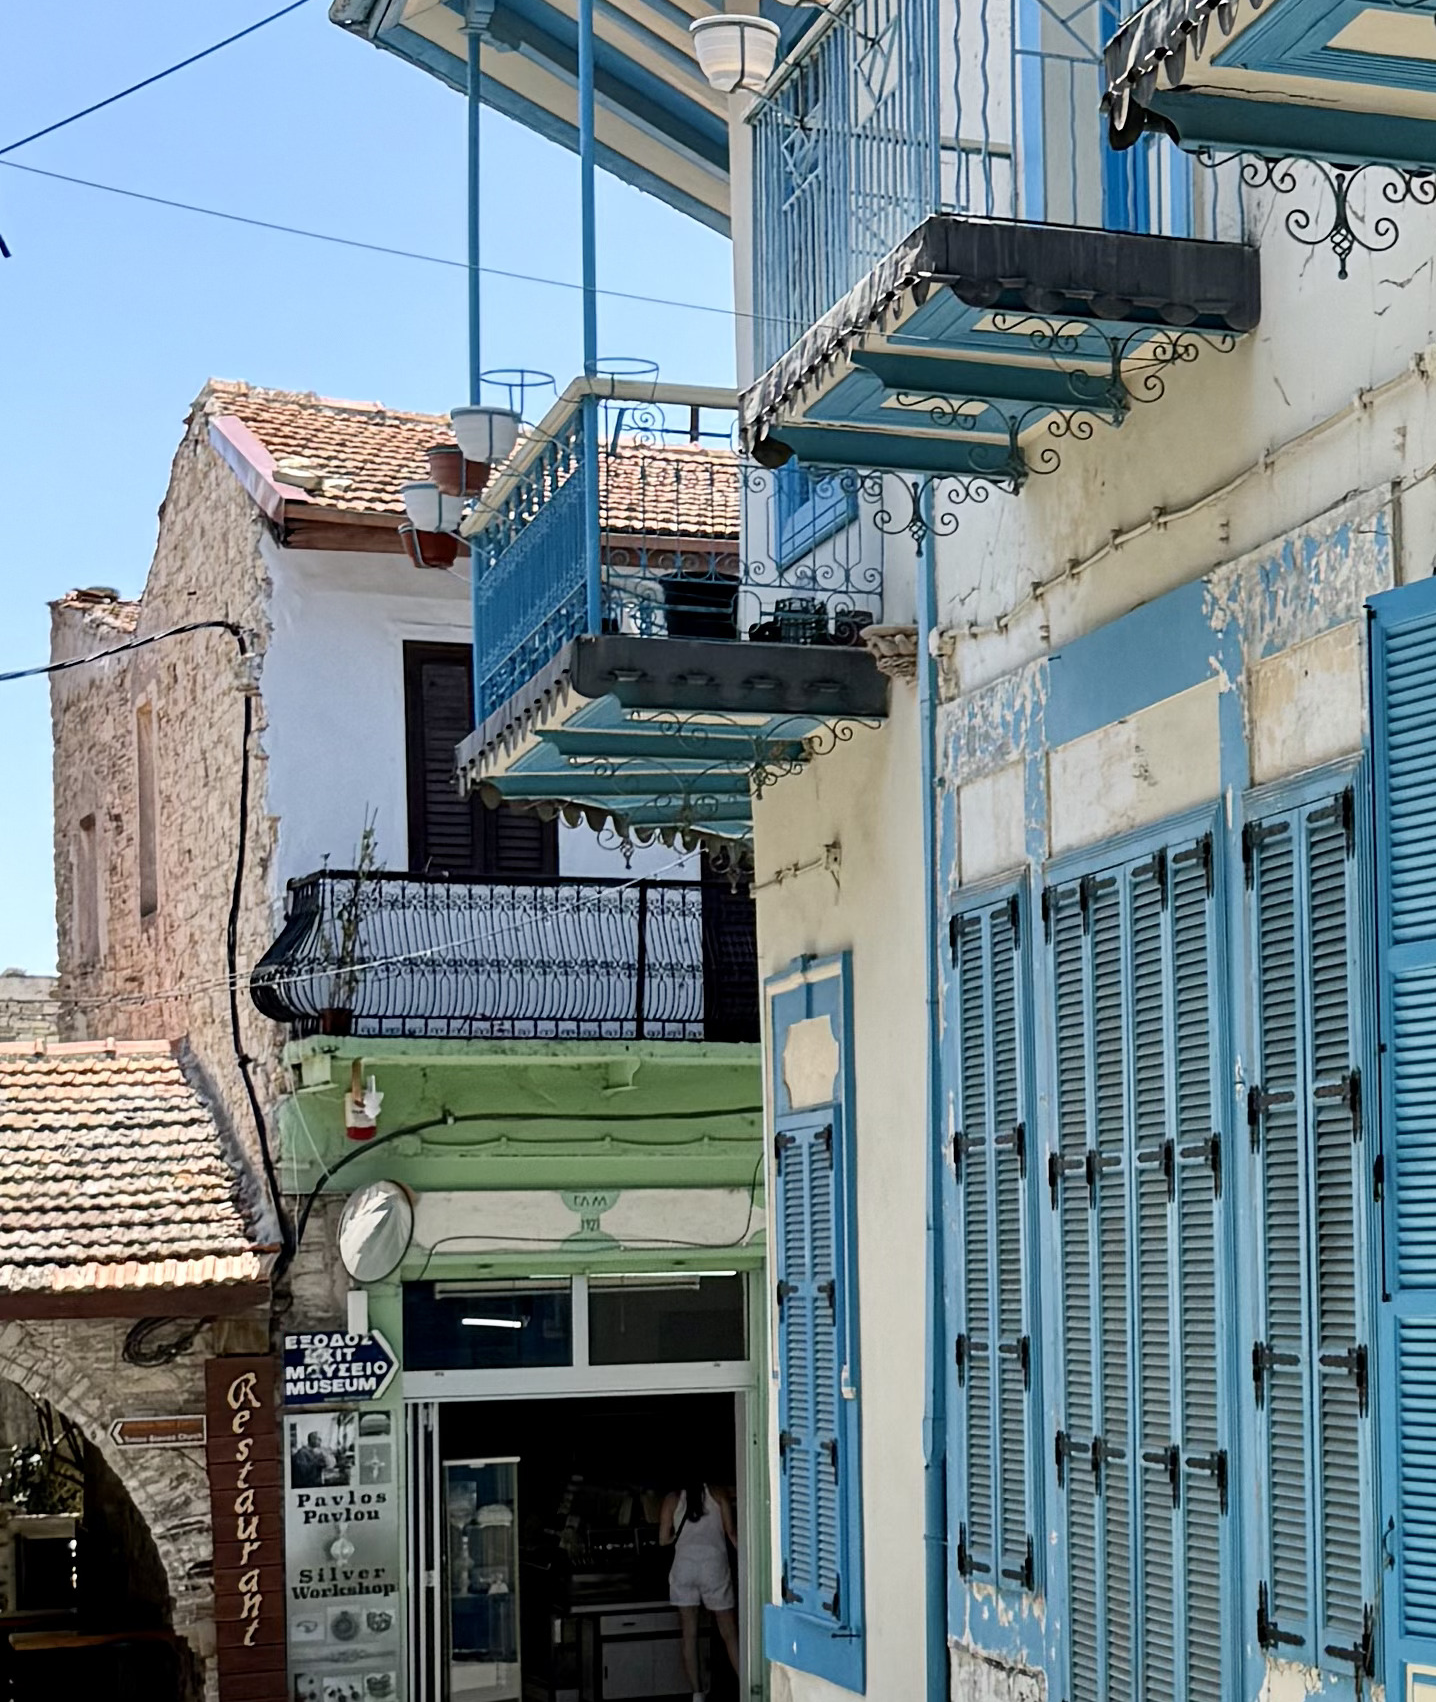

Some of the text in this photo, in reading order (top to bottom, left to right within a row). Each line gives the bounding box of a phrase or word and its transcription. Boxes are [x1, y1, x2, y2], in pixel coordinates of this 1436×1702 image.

[303, 1347, 356, 1365] EXIT
[285, 1377, 377, 1396] MUSEUM
[297, 1490, 387, 1508] Pavlos
[227, 1371, 263, 1647] Restaurant
[303, 1507, 380, 1525] Pavlou
[299, 1566, 386, 1584] Silver
[291, 1582, 397, 1600] Workshop
